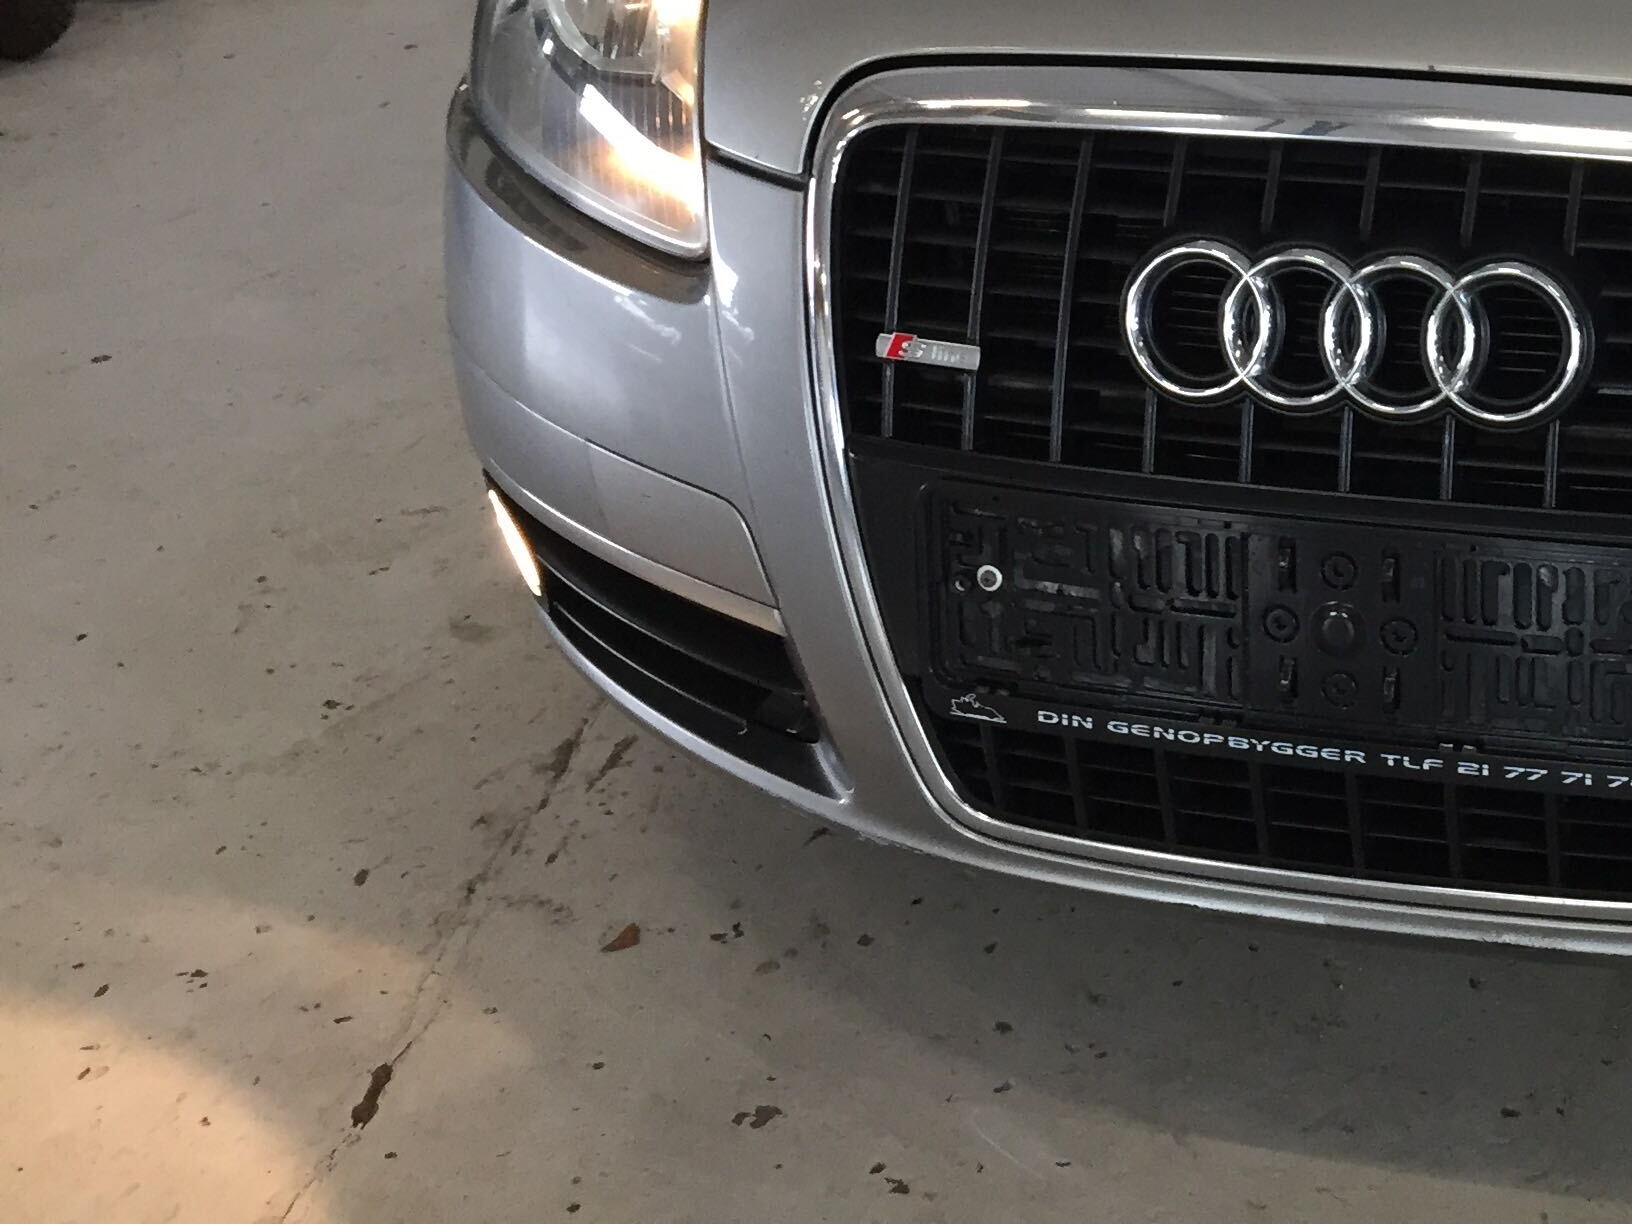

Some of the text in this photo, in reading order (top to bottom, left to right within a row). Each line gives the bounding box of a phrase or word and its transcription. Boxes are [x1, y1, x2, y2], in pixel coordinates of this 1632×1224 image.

[1037, 709, 1093, 729] DIN
[1107, 720, 1367, 765] GENOPBYGGER
[1380, 753, 1444, 771] TLF
[1503, 766, 1549, 781] 77
[1560, 771, 1592, 786] 71
